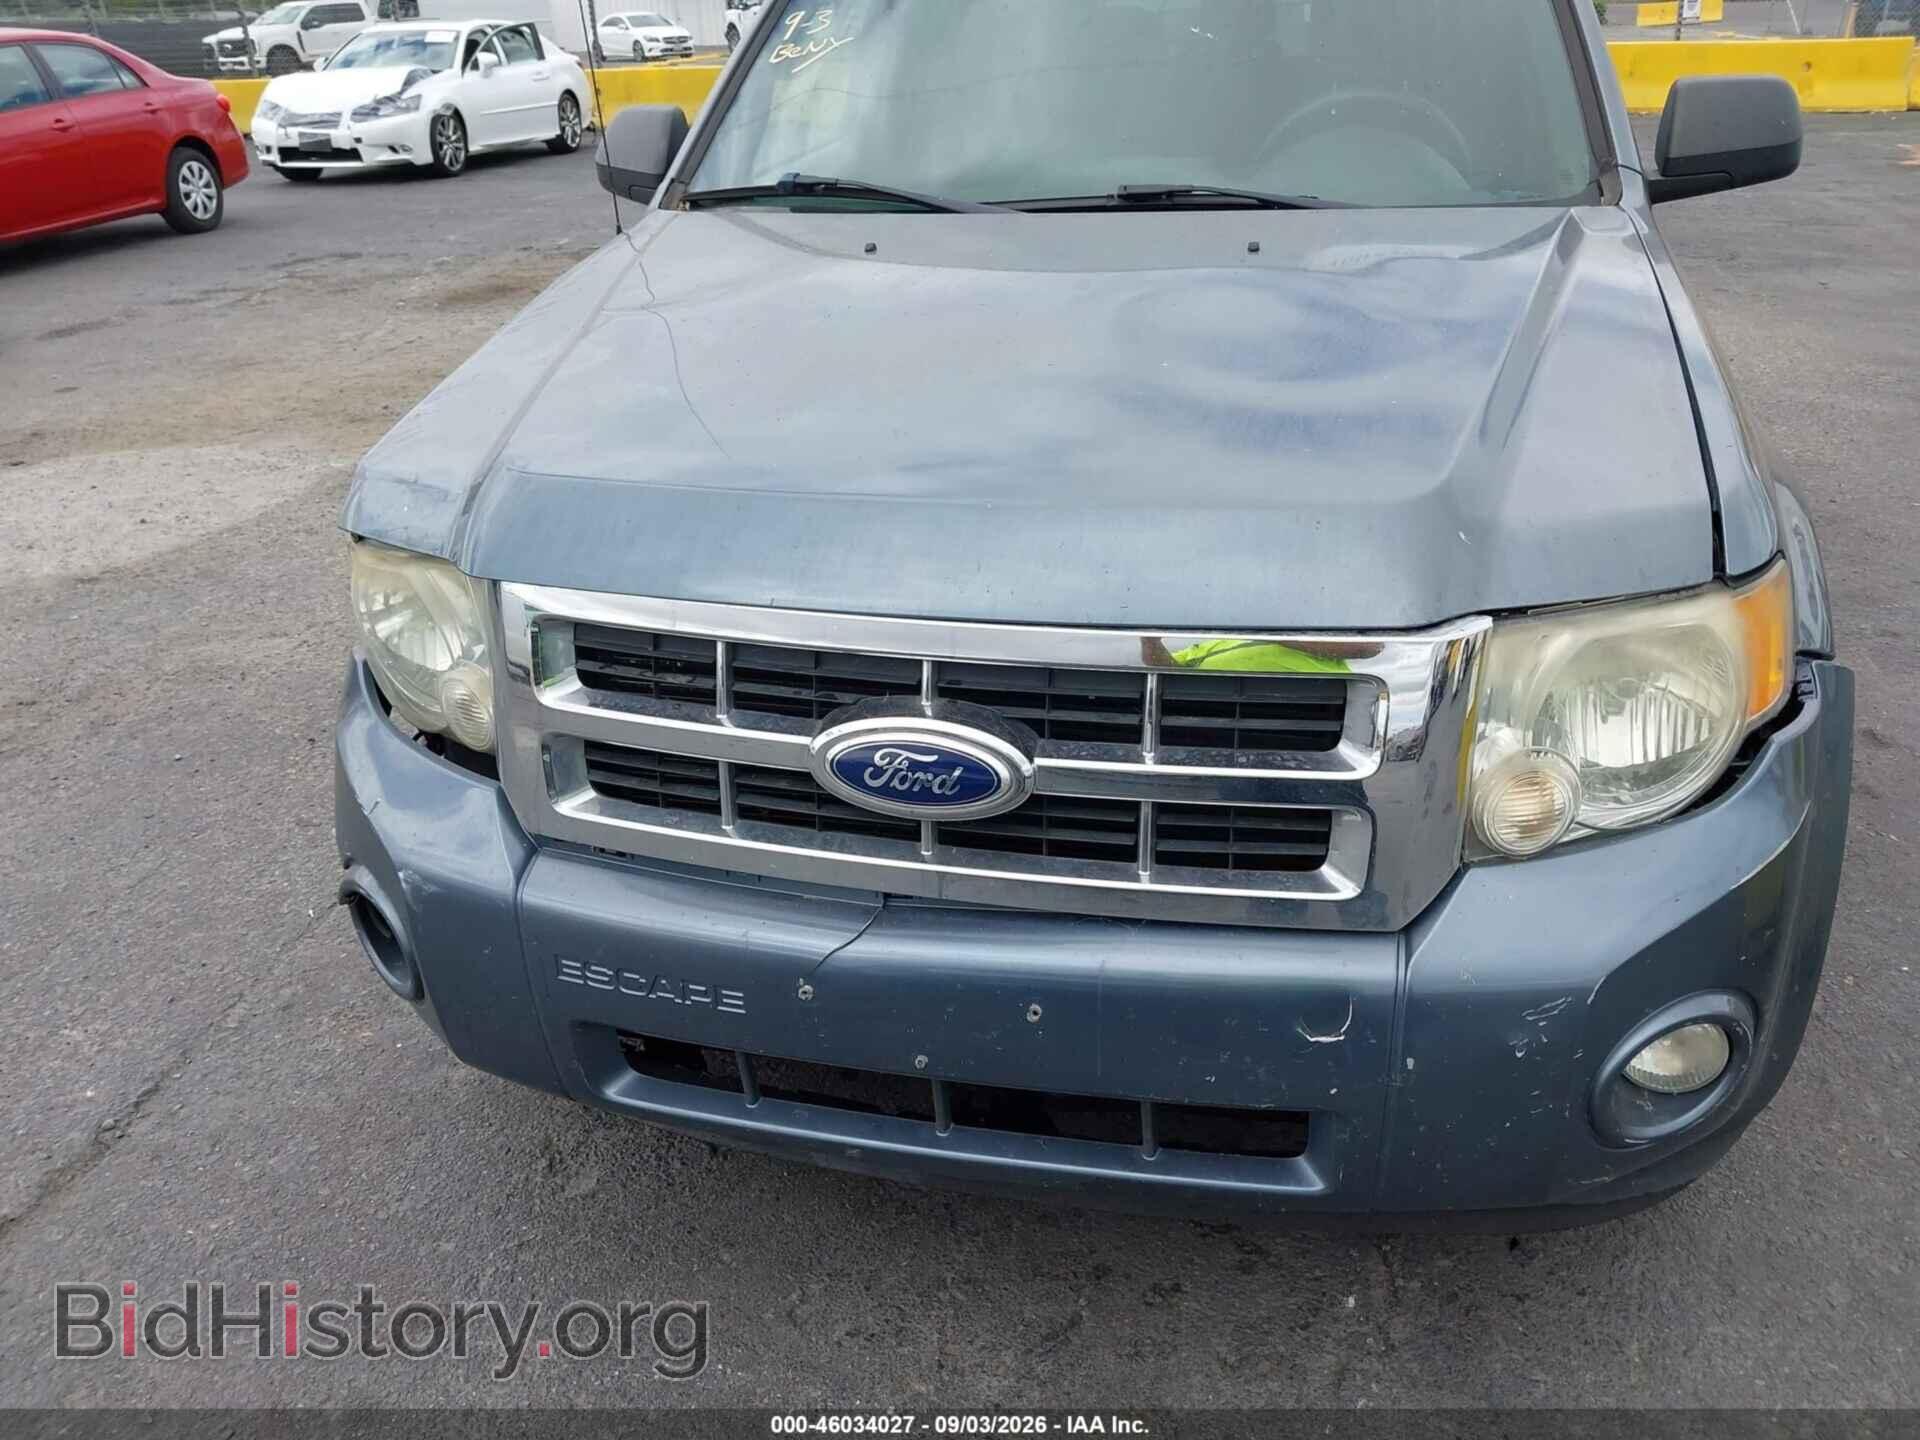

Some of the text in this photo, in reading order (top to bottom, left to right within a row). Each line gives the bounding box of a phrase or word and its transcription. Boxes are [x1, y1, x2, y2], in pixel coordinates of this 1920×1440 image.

[783, 9, 833, 41] 9-3
[863, 747, 963, 796] Ford
[554, 954, 747, 1014] ESCAPE
